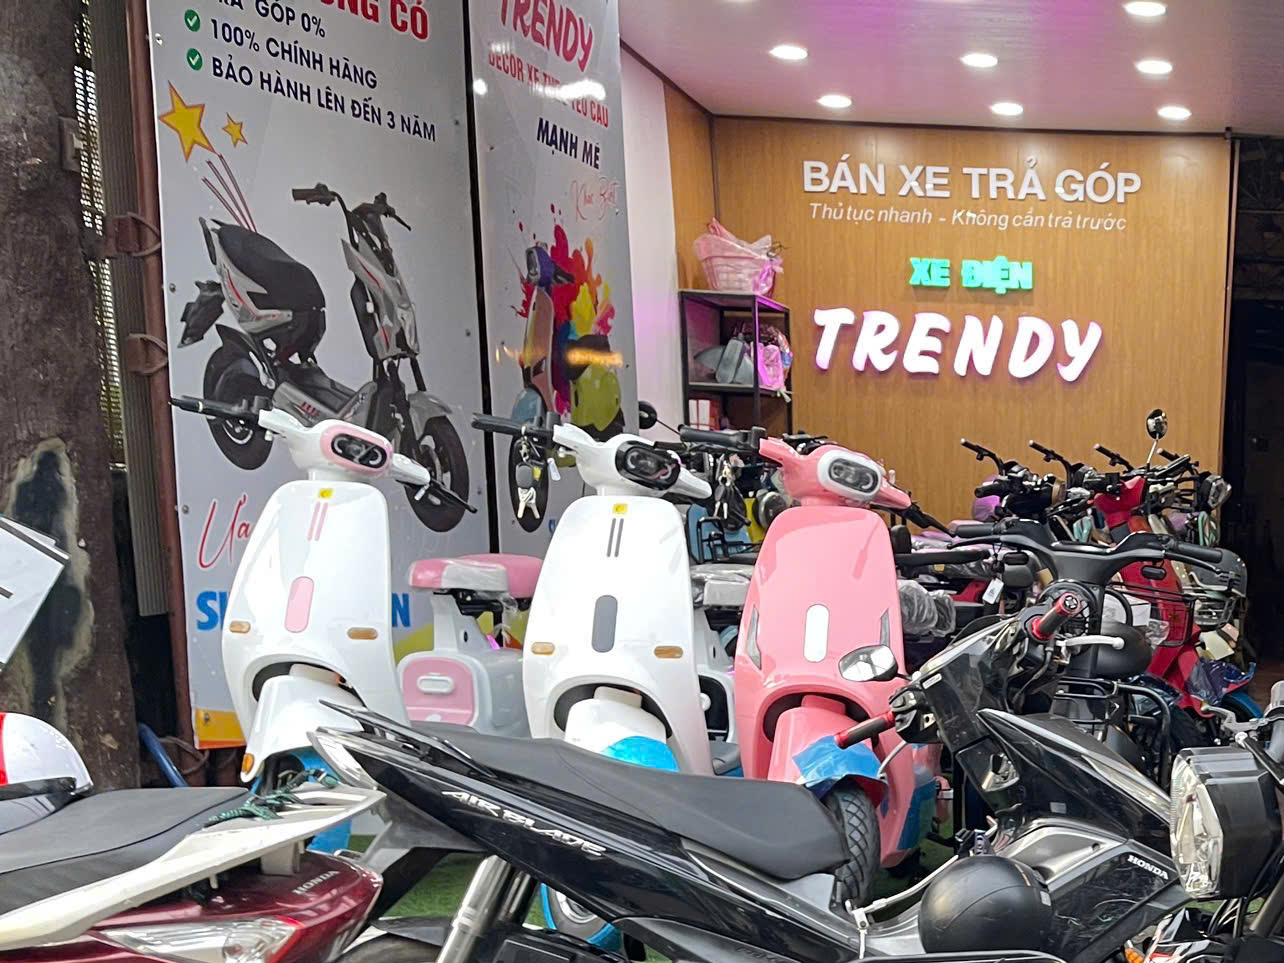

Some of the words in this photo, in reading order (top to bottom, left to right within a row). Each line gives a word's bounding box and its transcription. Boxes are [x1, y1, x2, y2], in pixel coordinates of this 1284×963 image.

[301, 13, 326, 37] 0%
[210, 19, 260, 52] 100%
[266, 37, 324, 72] CHÍNH
[329, 56, 377, 89] HÀNG
[212, 54, 253, 86] BẢO
[260, 70, 311, 104] HÀNH
[317, 86, 345, 114] LÊN
[351, 96, 382, 126] ĐẾN
[387, 110, 396, 130] 3
[400, 114, 436, 142] NĂM
[537, 117, 578, 159] MẠNH
[803, 154, 886, 196] BÁN
[898, 165, 950, 198] XE
[962, 155, 1046, 200] TRẢ
[1055, 162, 1142, 203] GÓP
[810, 202, 844, 220] Thủ
[847, 204, 875, 224] tục
[877, 207, 933, 224] nhanh
[951, 208, 1009, 230] Không
[1076, 212, 1127, 231] trước
[909, 257, 951, 287] XE
[961, 255, 1033, 294] ĐIỆN
[813, 307, 1103, 382] TRENDY
[442, 791, 501, 817] AIR
[503, 809, 607, 857] BLADE
[292, 870, 340, 894] HONDA
[1128, 854, 1169, 880] HONDA
